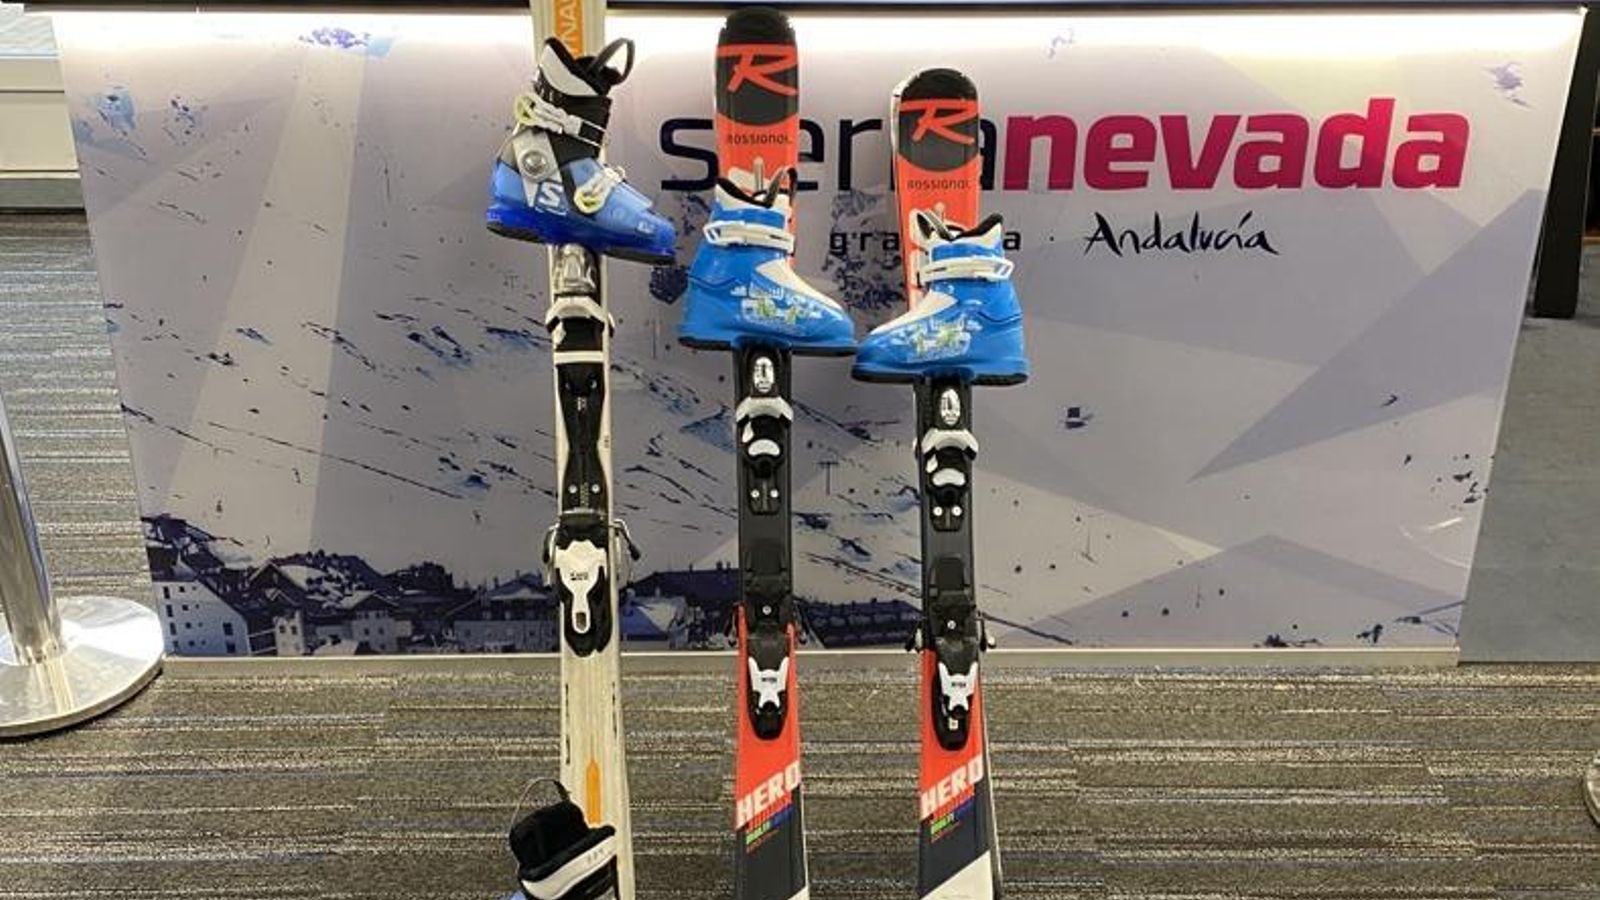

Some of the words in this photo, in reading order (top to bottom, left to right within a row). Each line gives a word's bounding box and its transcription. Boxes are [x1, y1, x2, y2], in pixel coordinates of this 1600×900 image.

[829, 231, 1021, 256] graa
[1084, 210, 1280, 256] Andalucía
[736, 760, 802, 830] HERO
[920, 753, 985, 821] HERO
